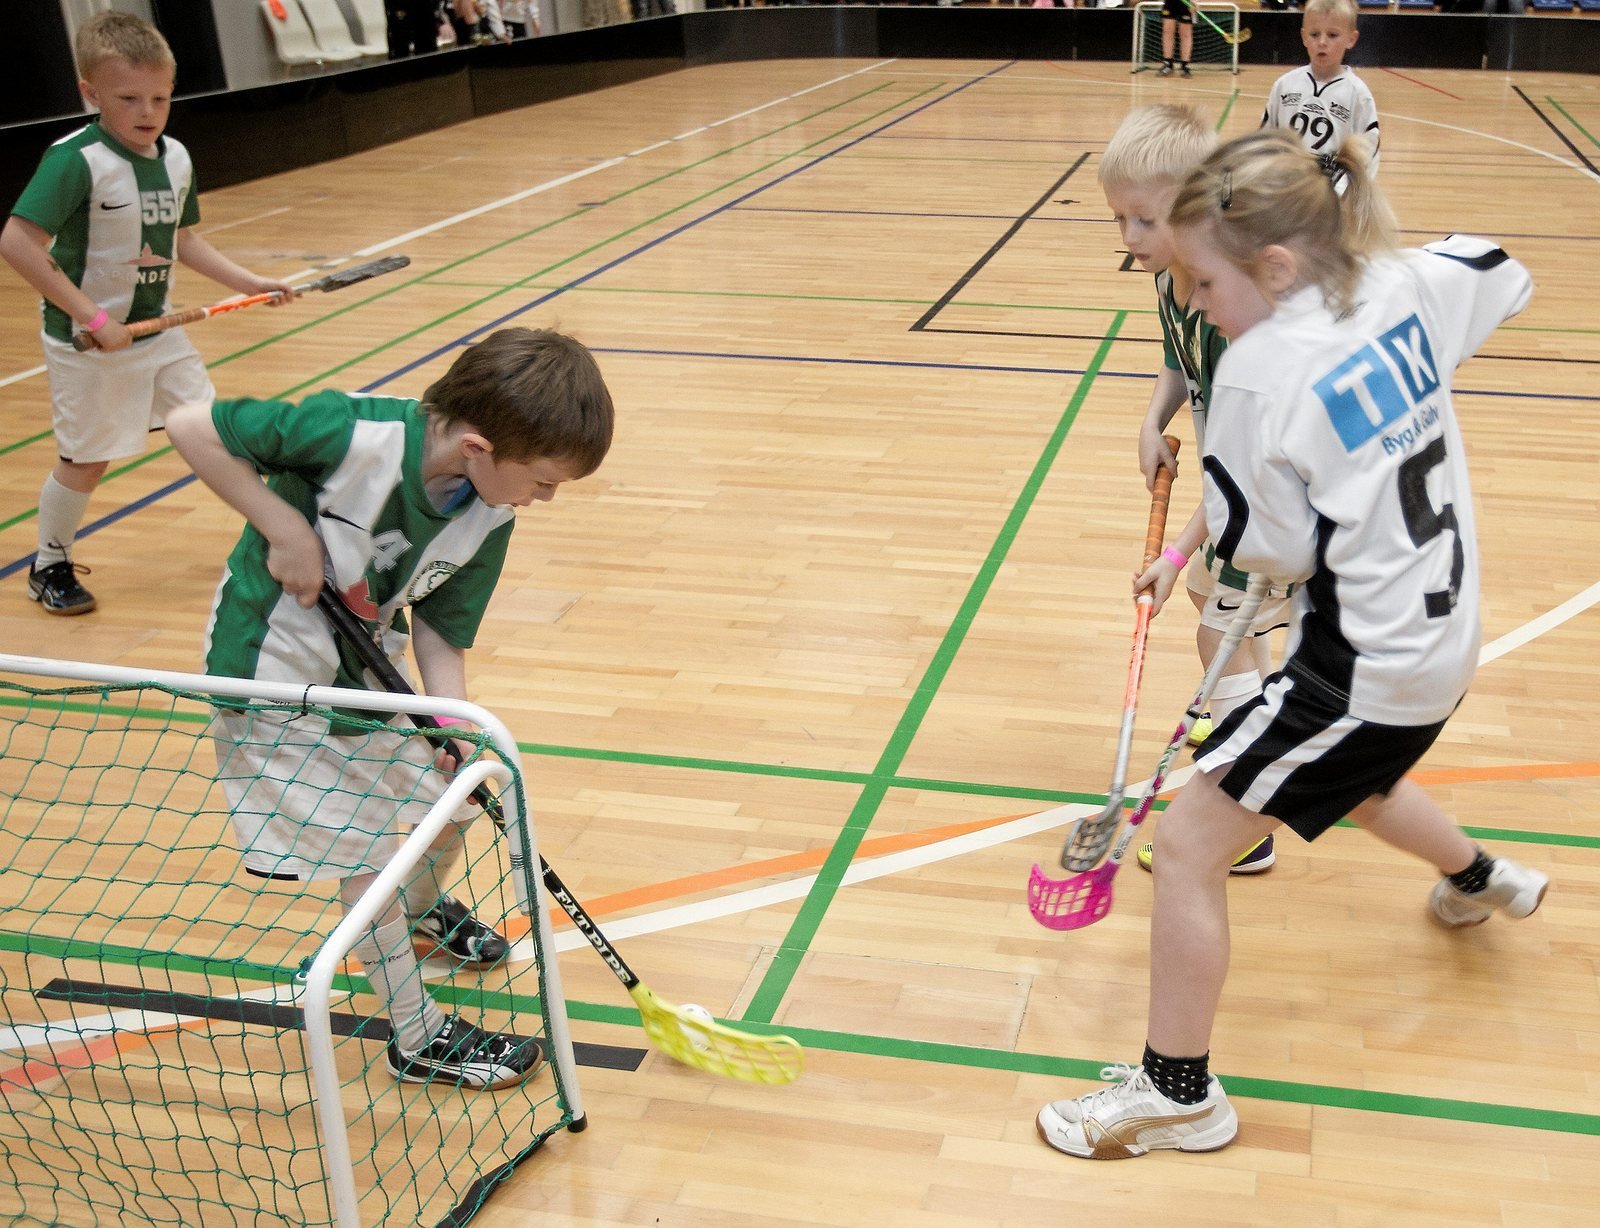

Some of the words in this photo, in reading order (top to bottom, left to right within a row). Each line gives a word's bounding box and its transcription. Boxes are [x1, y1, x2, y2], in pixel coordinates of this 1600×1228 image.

[1289, 112, 1334, 150] 99
[140, 189, 177, 225] 55
[1398, 432, 1464, 618] 5
[370, 529, 413, 574] 4
